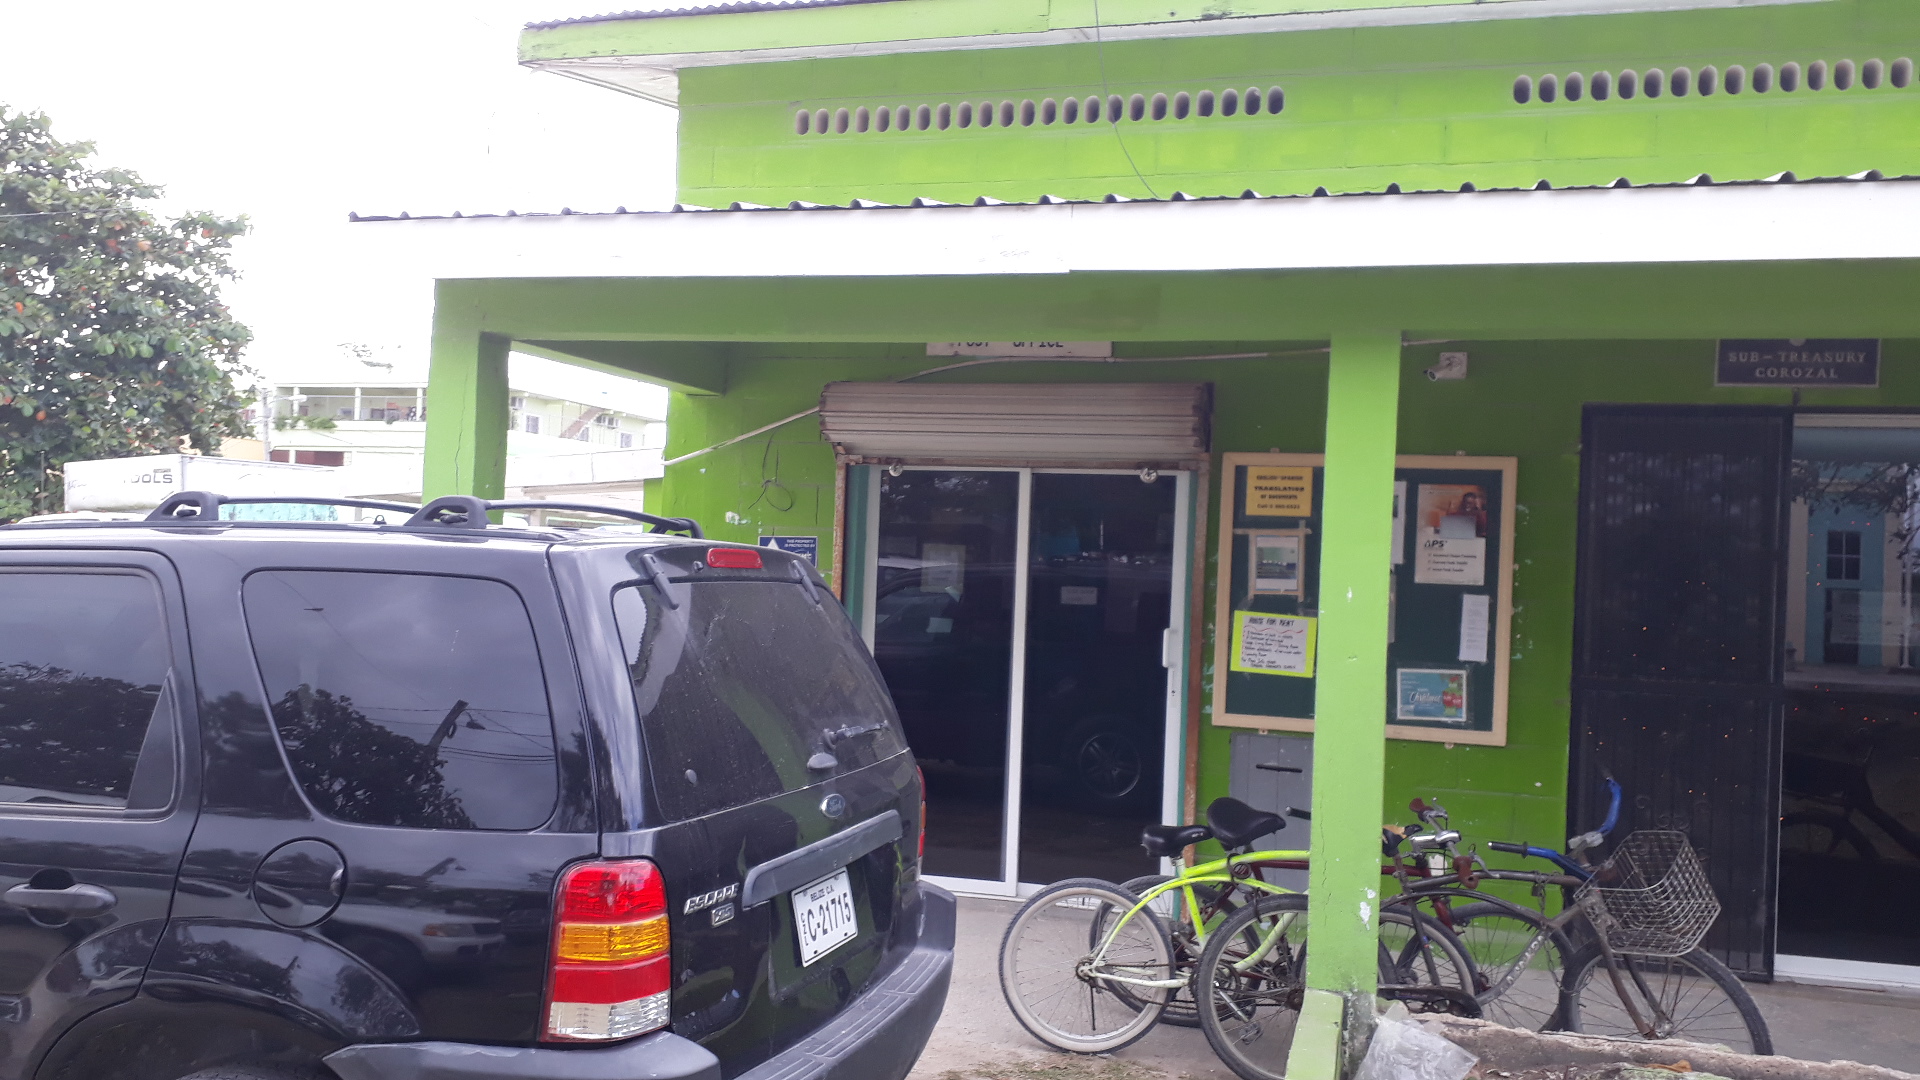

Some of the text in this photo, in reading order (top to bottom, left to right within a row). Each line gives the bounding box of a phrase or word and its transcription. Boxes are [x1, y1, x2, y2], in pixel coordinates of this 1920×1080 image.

[1755, 367, 1838, 379] COROZAL
[683, 882, 740, 916] ESCAPE
[810, 889, 826, 902] BELIZE
[807, 892, 852, 942] C-21715
